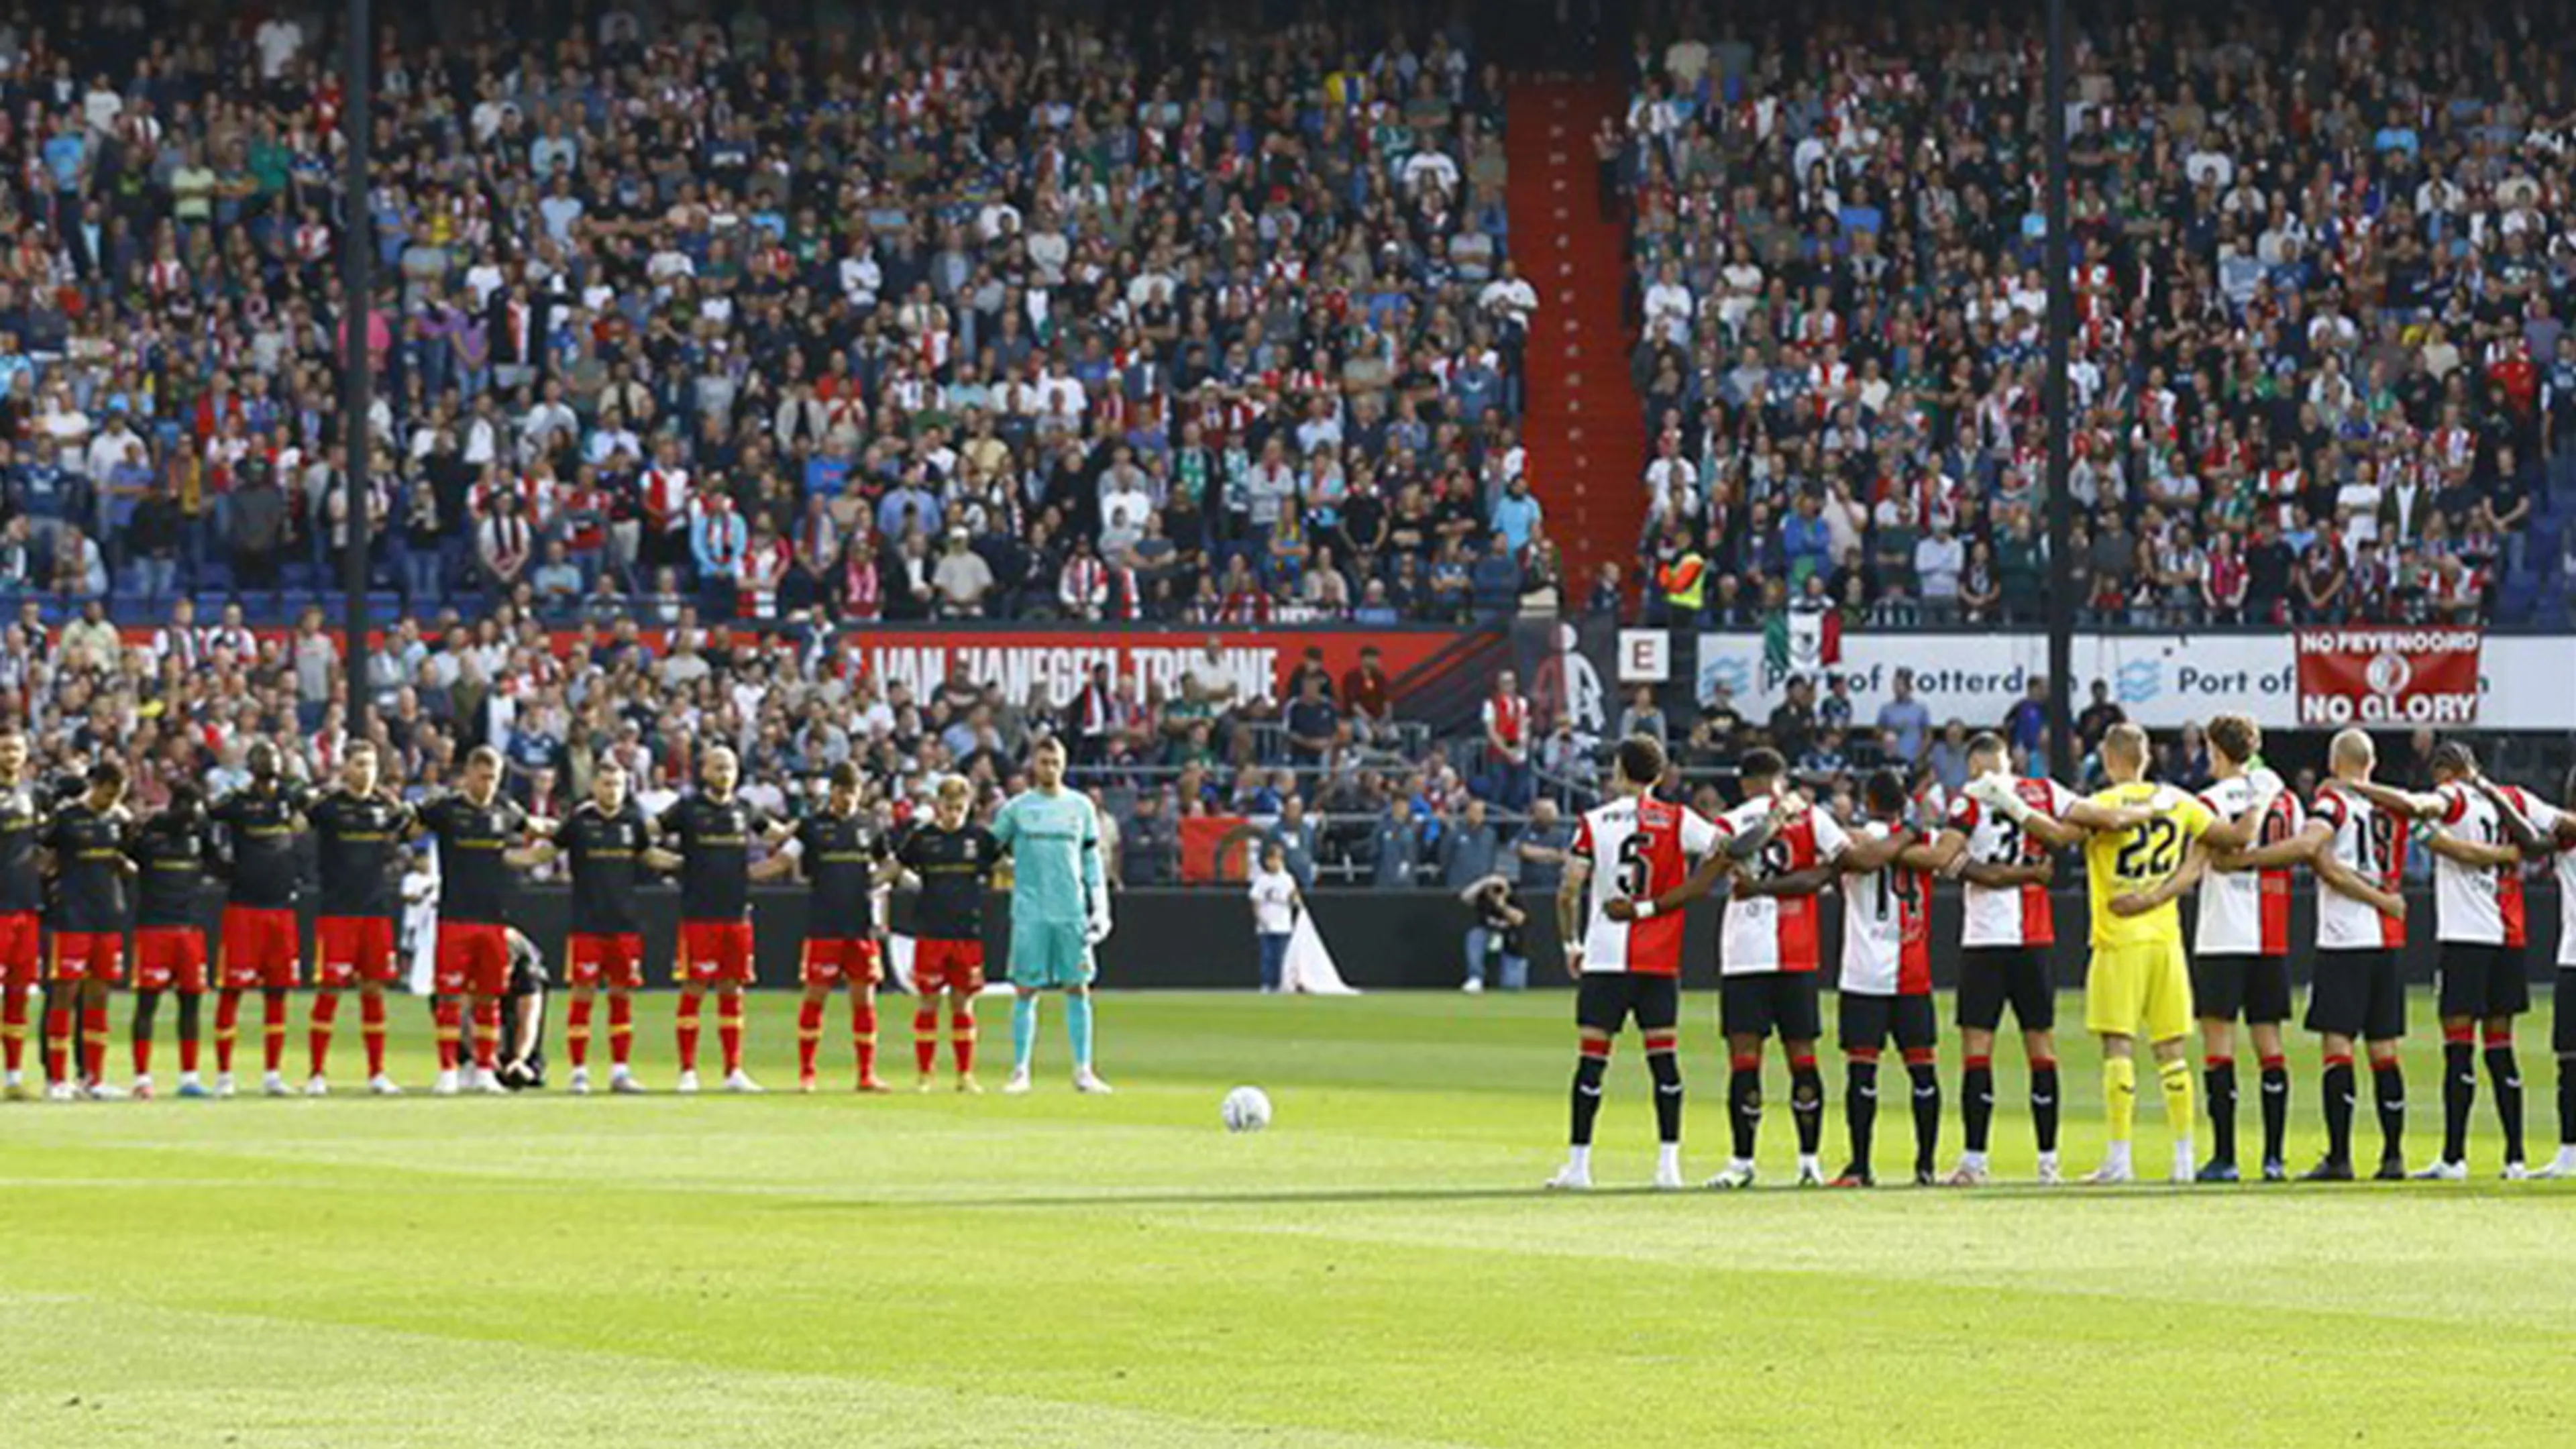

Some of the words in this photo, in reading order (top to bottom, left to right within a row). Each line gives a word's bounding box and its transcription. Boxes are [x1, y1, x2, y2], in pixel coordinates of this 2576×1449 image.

[1633, 639, 1655, 669] E
[2301, 632, 2334, 653] NO
[1849, 662, 1882, 692] of
[2179, 667, 2247, 694] Port
[2259, 663, 2293, 694] of
[2303, 694, 2353, 722] NO
[2360, 693, 2475, 722] GLORY
[2115, 816, 2178, 878] 22
[1617, 833, 1655, 896] 5
[1876, 860, 1923, 922] 14
